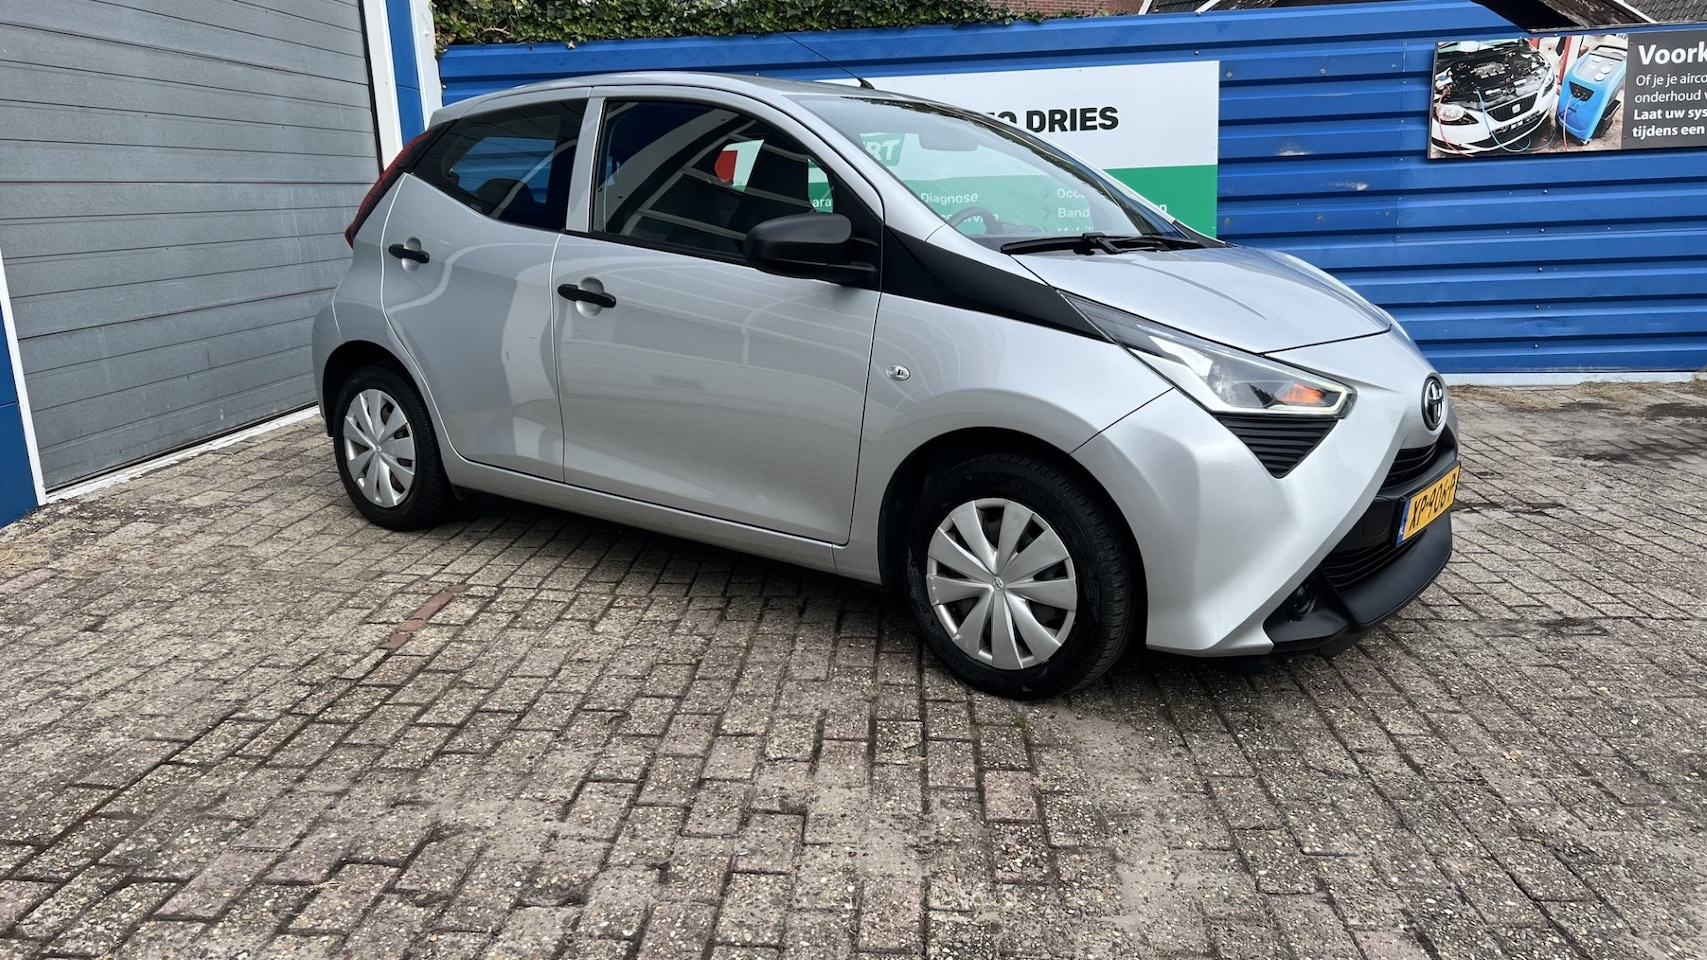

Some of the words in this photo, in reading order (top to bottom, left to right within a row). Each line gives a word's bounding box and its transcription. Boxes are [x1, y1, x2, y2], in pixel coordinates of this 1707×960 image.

[1638, 41, 1707, 65] Voork
[1636, 74, 1652, 86] Of
[1652, 73, 1664, 88] je
[1665, 73, 1677, 88] je
[1680, 73, 1707, 84] airco
[1634, 89, 1702, 103] onderhoud
[1026, 106, 1119, 133] DRIES
[1633, 109, 1662, 120] Laat
[1665, 109, 1685, 119] uw
[1688, 109, 1707, 120] sys
[1632, 125, 1678, 140] tijdens
[1680, 125, 1705, 135] een
[921, 193, 979, 205] Diagnose
